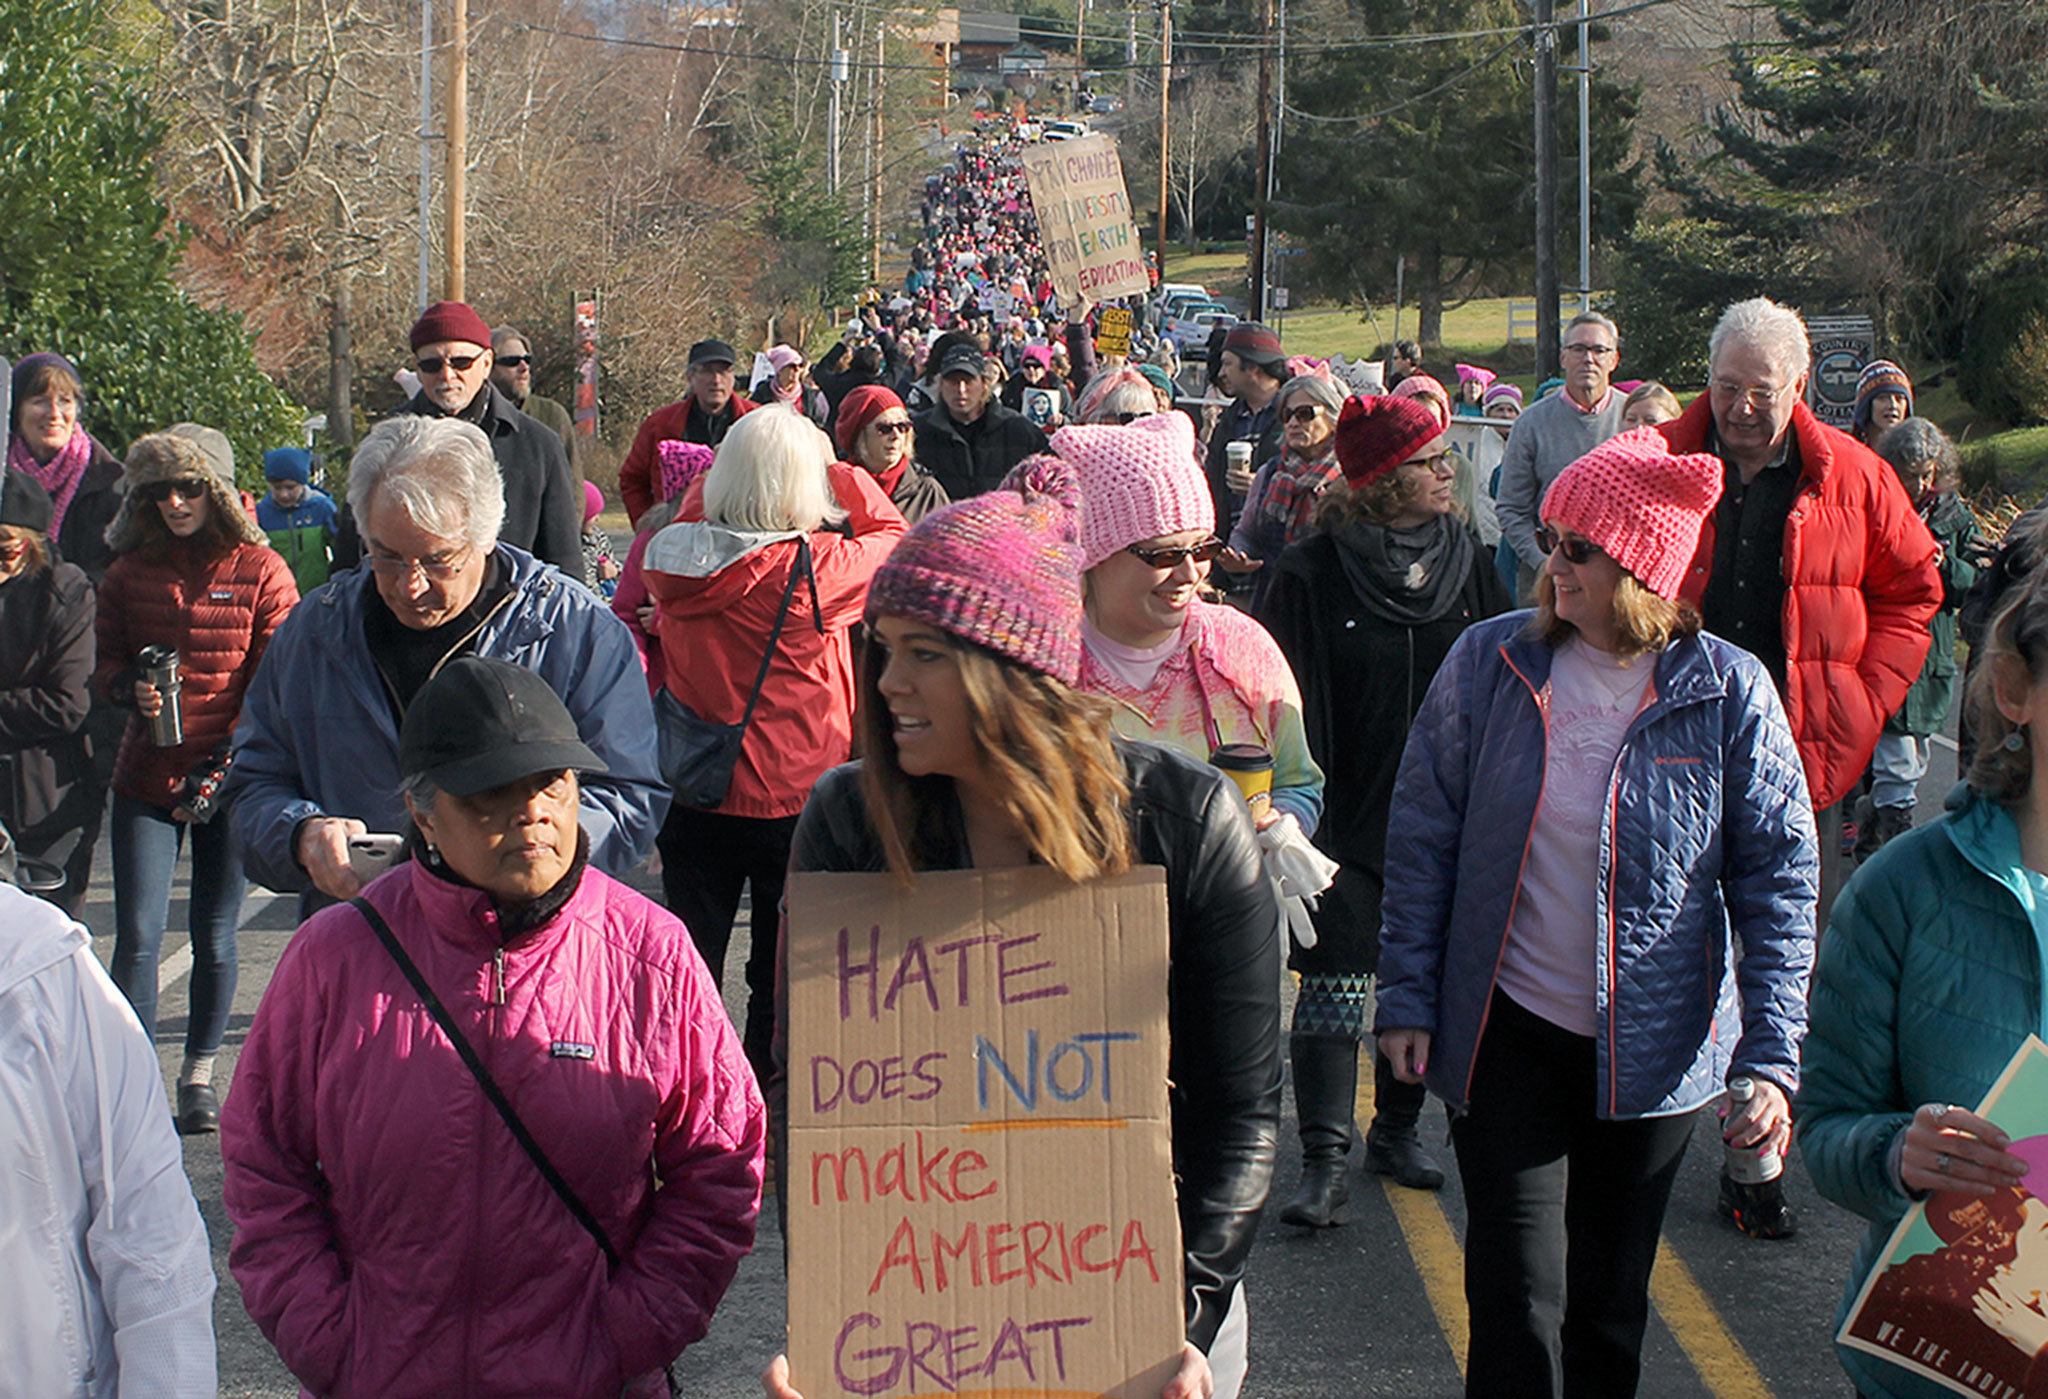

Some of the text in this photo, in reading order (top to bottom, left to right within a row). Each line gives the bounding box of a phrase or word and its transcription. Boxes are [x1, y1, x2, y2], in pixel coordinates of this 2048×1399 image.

[1067, 150, 1119, 183] CHOICE
[1063, 191, 1126, 226] DIVERSITY
[1078, 222, 1128, 257] EARTH
[1078, 257, 1144, 291] EDUCATION
[1813, 338, 1868, 353] COUNTRY
[1815, 404, 1856, 418] COTTA
[836, 925, 1070, 1021] HATE
[810, 1029, 1141, 1114] DOES NOT
[810, 1131, 998, 1207] make
[867, 1216, 1160, 1297] AMERICA
[833, 1311, 1092, 1396] GREAT
[1875, 1320, 1905, 1347] WE
[1912, 1336, 1951, 1368] THE
